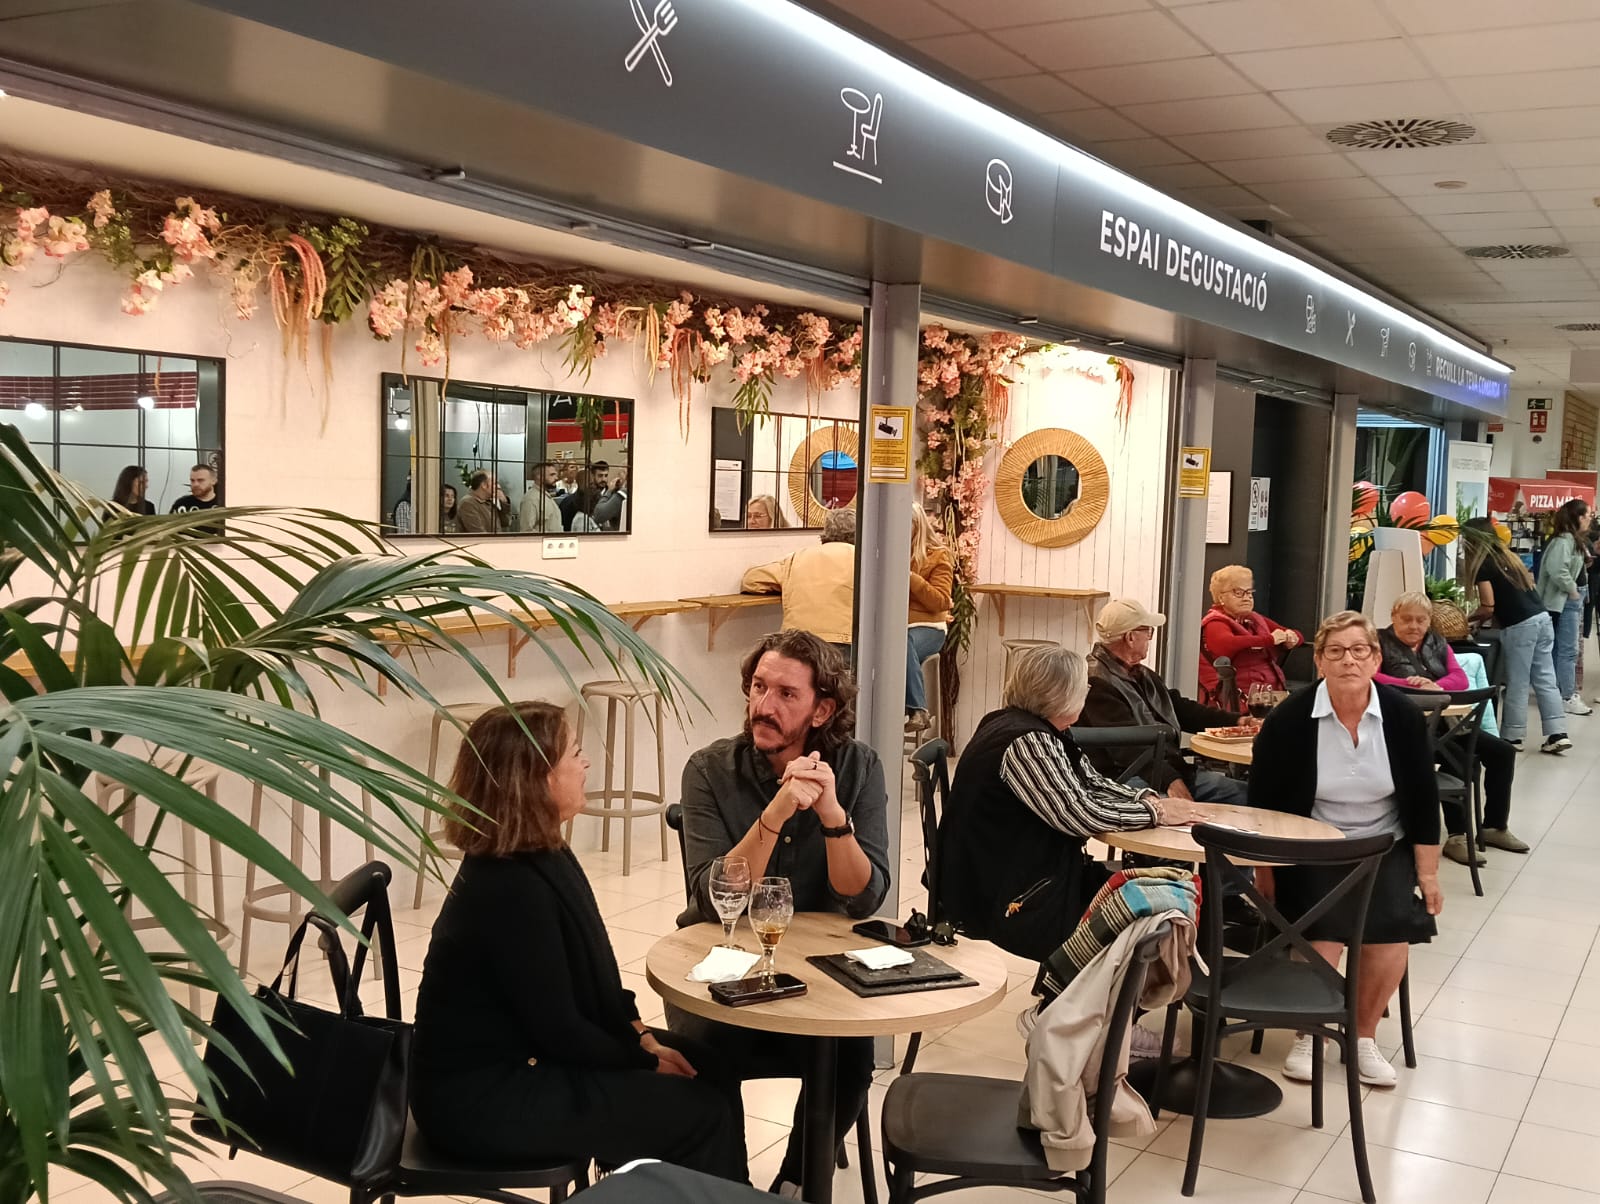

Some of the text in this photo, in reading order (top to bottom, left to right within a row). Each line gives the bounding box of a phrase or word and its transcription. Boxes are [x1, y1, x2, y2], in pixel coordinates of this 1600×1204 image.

[1100, 209, 1268, 312] ESPAI DEGUSTACIÓ
[1530, 494, 1554, 509] PIZZA
